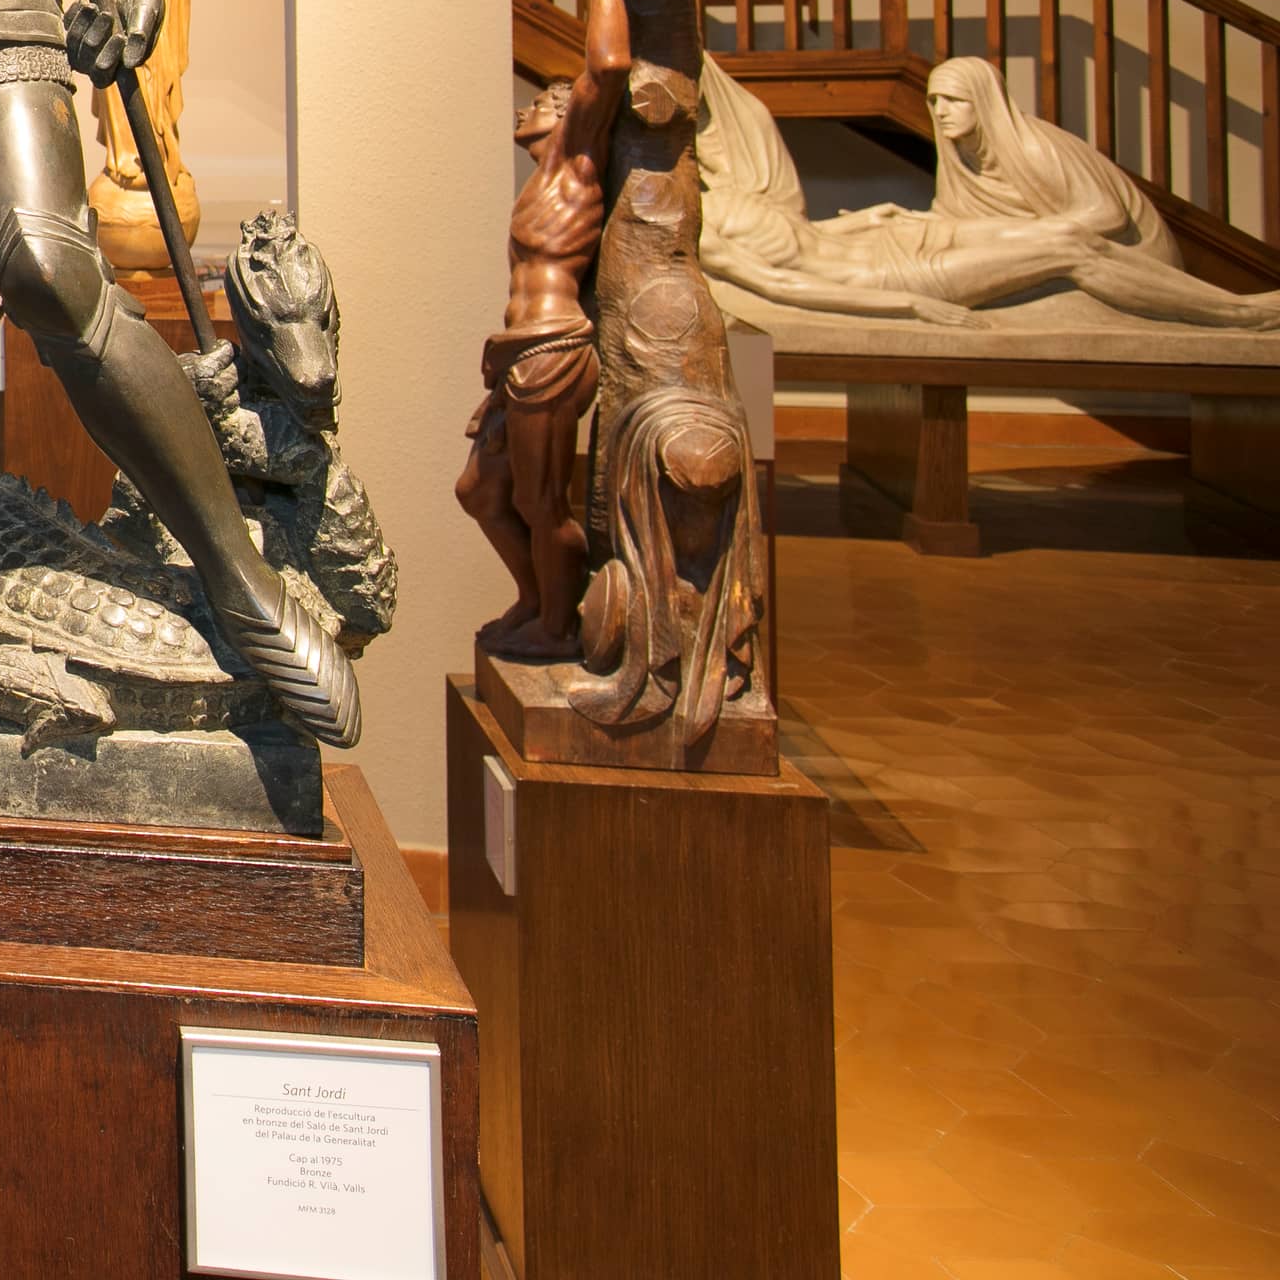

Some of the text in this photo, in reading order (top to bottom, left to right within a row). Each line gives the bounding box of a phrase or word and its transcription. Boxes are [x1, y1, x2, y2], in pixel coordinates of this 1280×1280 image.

[282, 1083, 346, 1100] Sant Jordi
[254, 1104, 376, 1122] Reproducció de l'escultura
[243, 1117, 389, 1136] en bronze del Saló de Sant Jordi
[255, 1129, 376, 1148] del Palau de la Generalitat
[289, 1153, 343, 1167] Cap al 1975
[300, 1167, 332, 1178] Bronze
[267, 1176, 306, 1188] Fundició
[343, 1183, 366, 1193] Valls
